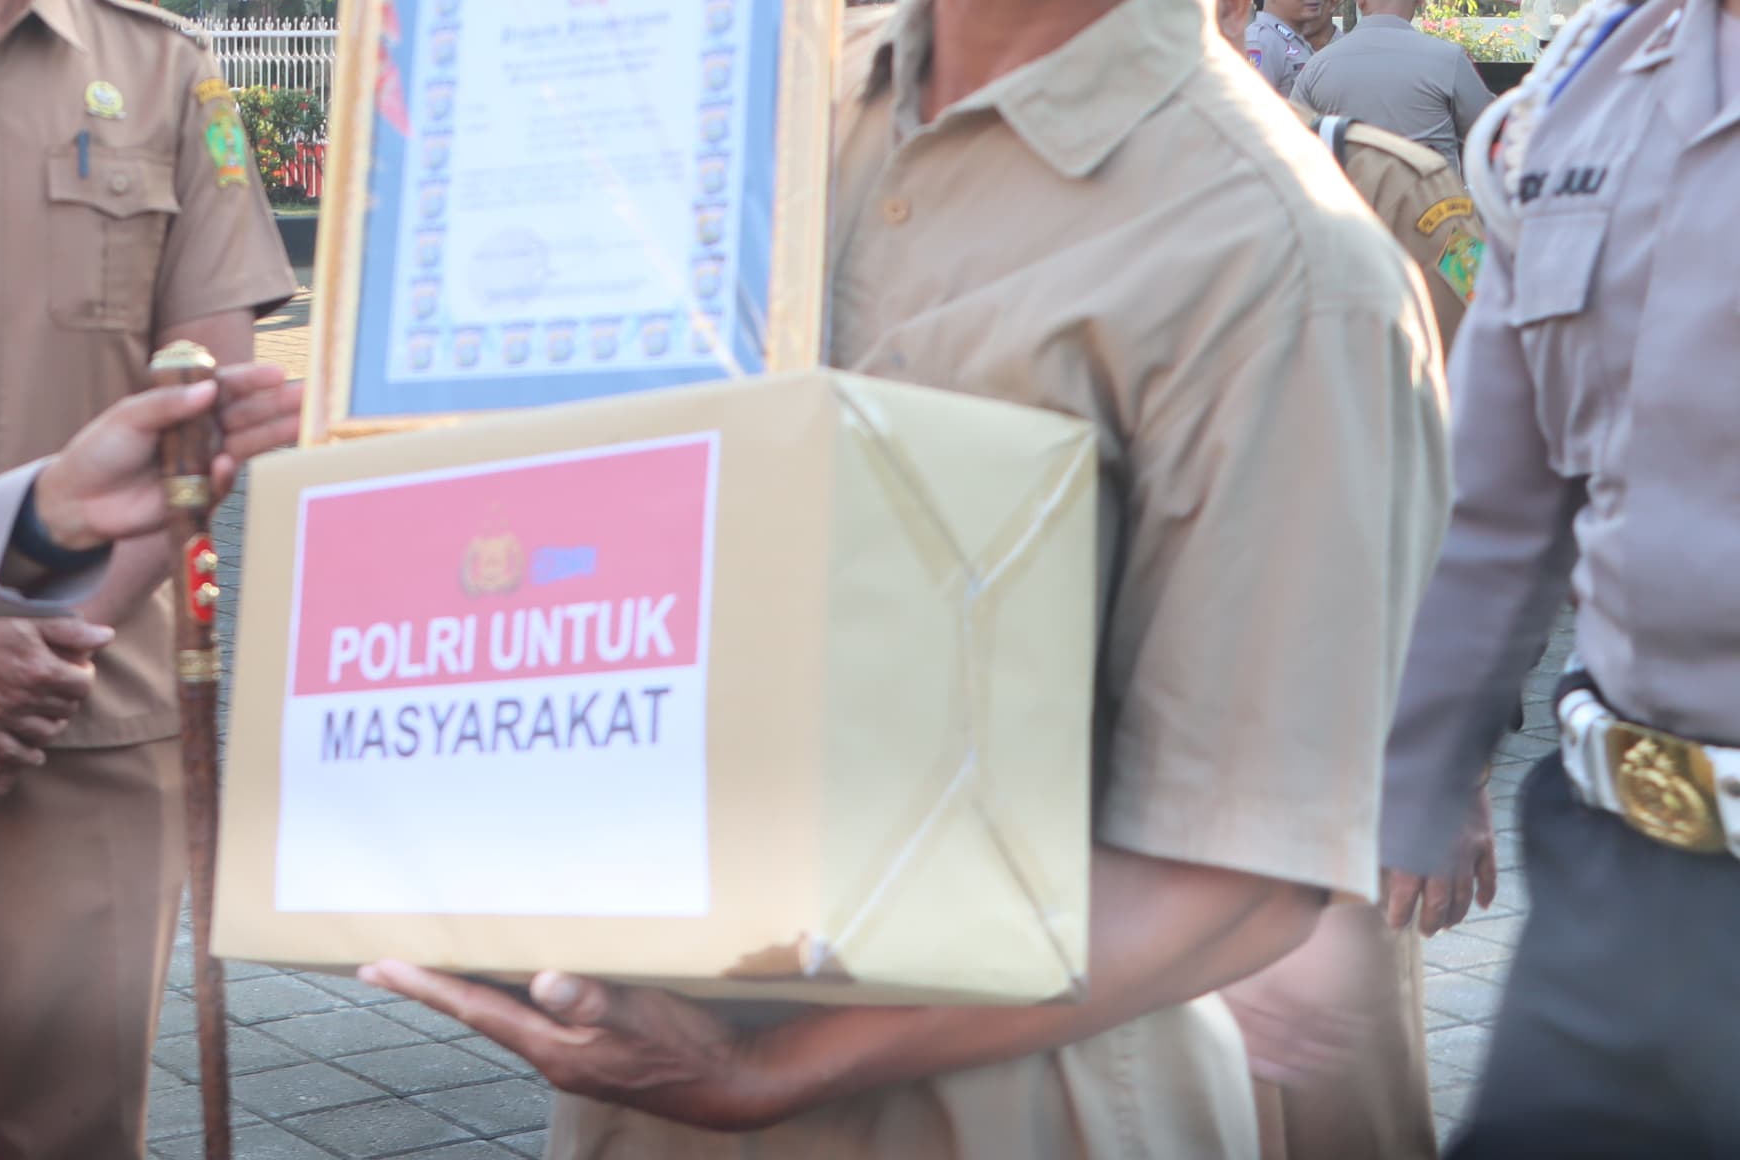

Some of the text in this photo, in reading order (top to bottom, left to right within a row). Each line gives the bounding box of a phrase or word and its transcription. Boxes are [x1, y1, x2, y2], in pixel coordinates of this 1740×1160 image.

[326, 594, 678, 683] POLRI UNTUK
[319, 685, 674, 764] MASYARAKAT
